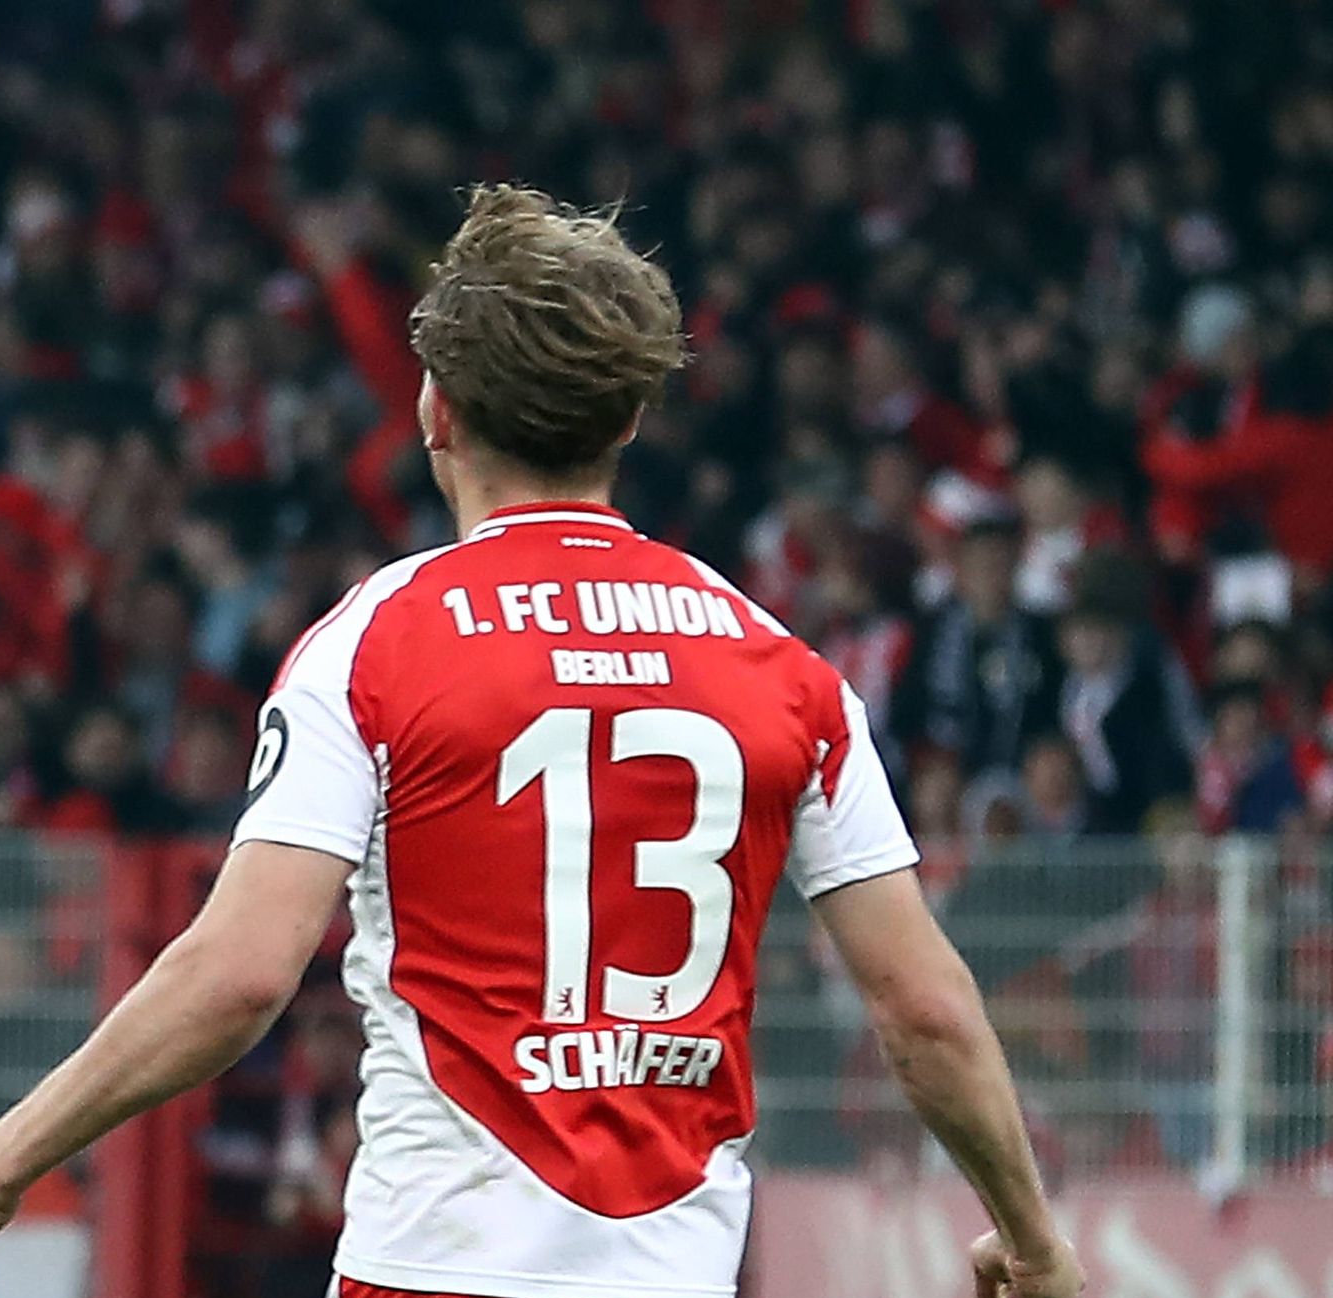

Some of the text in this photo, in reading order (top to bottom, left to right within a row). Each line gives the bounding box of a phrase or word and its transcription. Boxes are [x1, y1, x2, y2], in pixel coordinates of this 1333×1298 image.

[442, 581, 746, 640] 1. FC UNION
[550, 648, 672, 685] BERLIN
[496, 707, 744, 1025] 13
[515, 1023, 724, 1094] SCHÄFER
